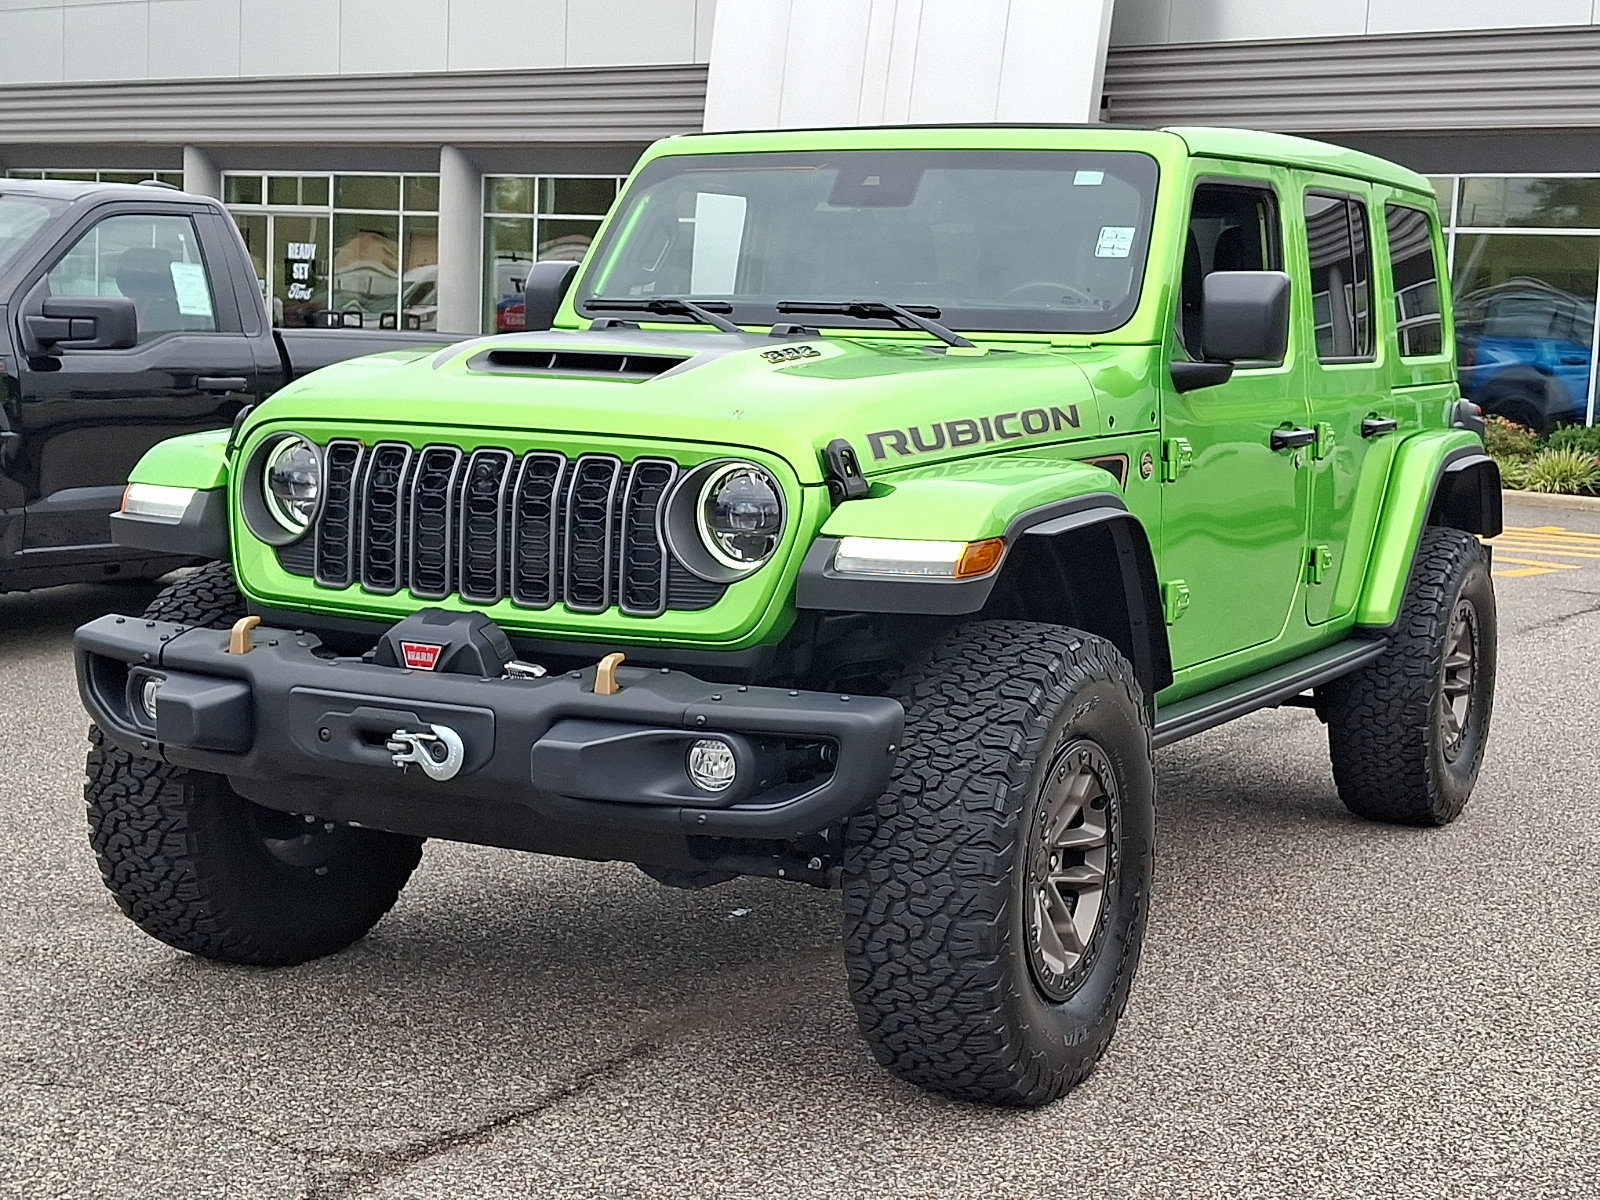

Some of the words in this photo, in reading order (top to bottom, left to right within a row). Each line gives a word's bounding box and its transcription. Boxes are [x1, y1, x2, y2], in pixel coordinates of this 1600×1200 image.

[288, 242, 316, 260] READY
[292, 262, 310, 280] SET
[288, 282, 314, 300] Ford
[867, 404, 1081, 461] RUBICON
[407, 650, 434, 663] WARN
